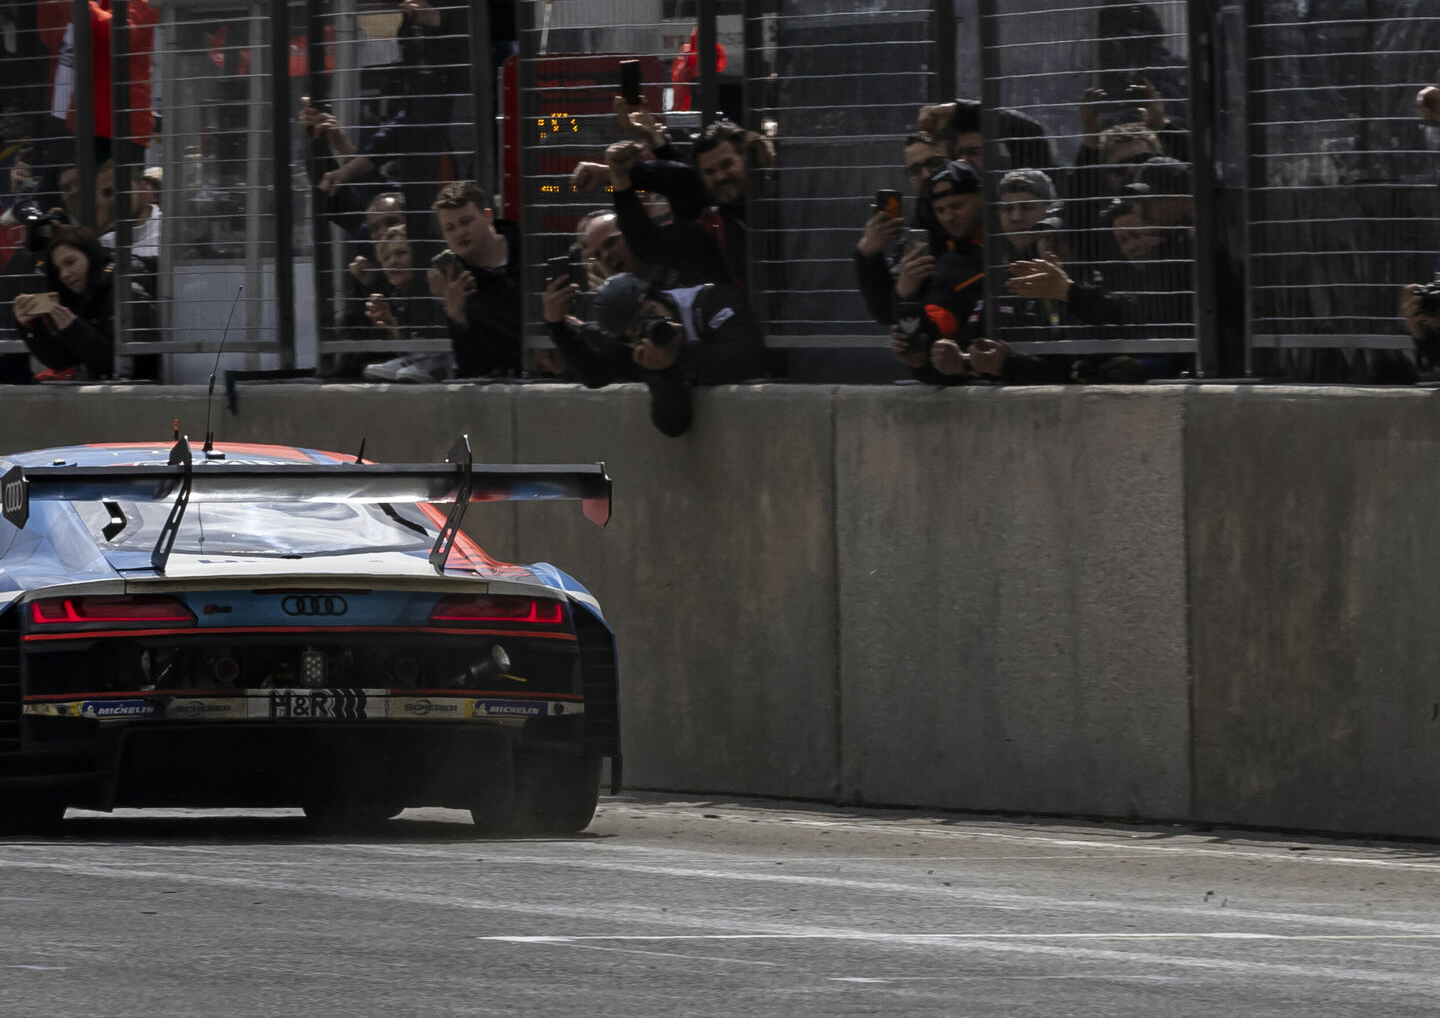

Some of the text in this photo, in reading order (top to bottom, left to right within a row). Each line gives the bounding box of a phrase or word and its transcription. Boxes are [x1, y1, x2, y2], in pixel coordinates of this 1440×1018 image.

[97, 703, 156, 716] MICHELIN
[268, 691, 332, 720] H&R
[488, 705, 540, 715] MICHELIN
